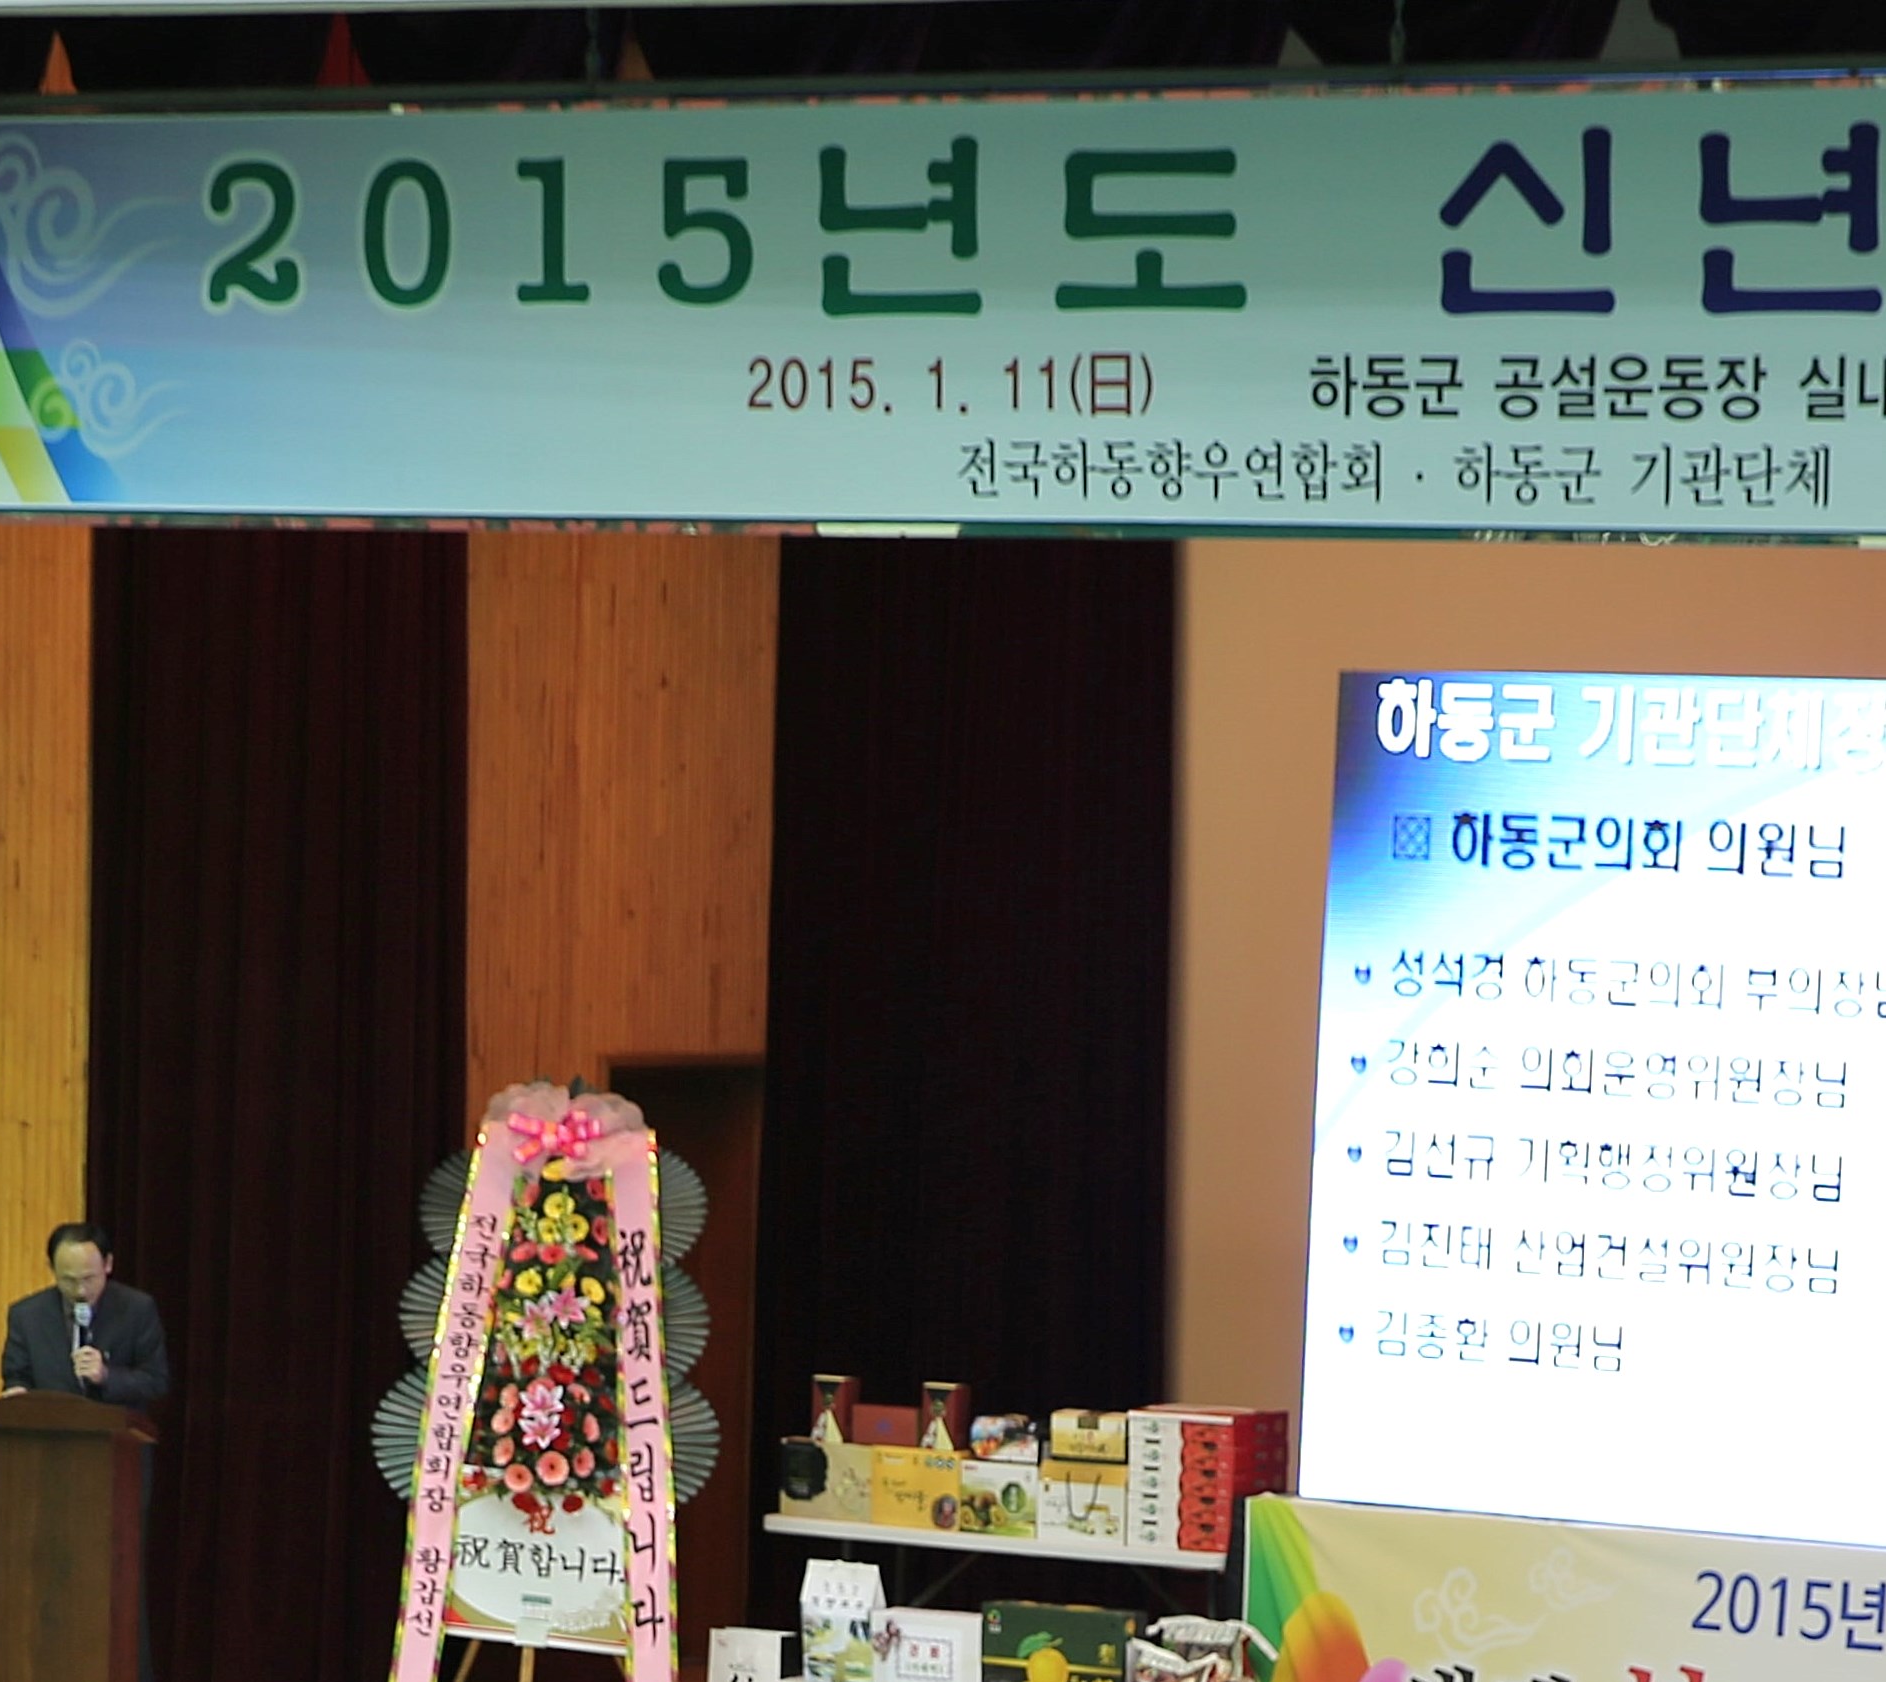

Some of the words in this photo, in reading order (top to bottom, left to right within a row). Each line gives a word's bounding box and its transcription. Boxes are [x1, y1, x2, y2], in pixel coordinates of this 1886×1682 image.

[201, 130, 1252, 320] 2015년도
[1310, 352, 1464, 423] 하동군
[1493, 353, 1767, 423] 공설운동장
[954, 438, 1387, 506] 전국하동향우연합회
[1453, 442, 1606, 509] 하동군
[1631, 444, 1833, 509] 기관단체
[1376, 677, 1555, 762] 하동군
[1451, 812, 1682, 871] 하동군의회
[1708, 820, 1845, 879] 의원님
[1391, 948, 1505, 999] 성석경
[1525, 957, 1723, 1007] 하동군의회
[1520, 1046, 1846, 1108] 의회운영위원장님
[1384, 1131, 1494, 1180] 김선규
[1518, 1138, 1842, 1202] 기획행정위원장님
[1381, 1221, 1492, 1270] 김진태
[1515, 1229, 1838, 1294] 산업건설위원장님
[1376, 1311, 1488, 1361] 김종환
[1509, 1320, 1622, 1371] 의원님
